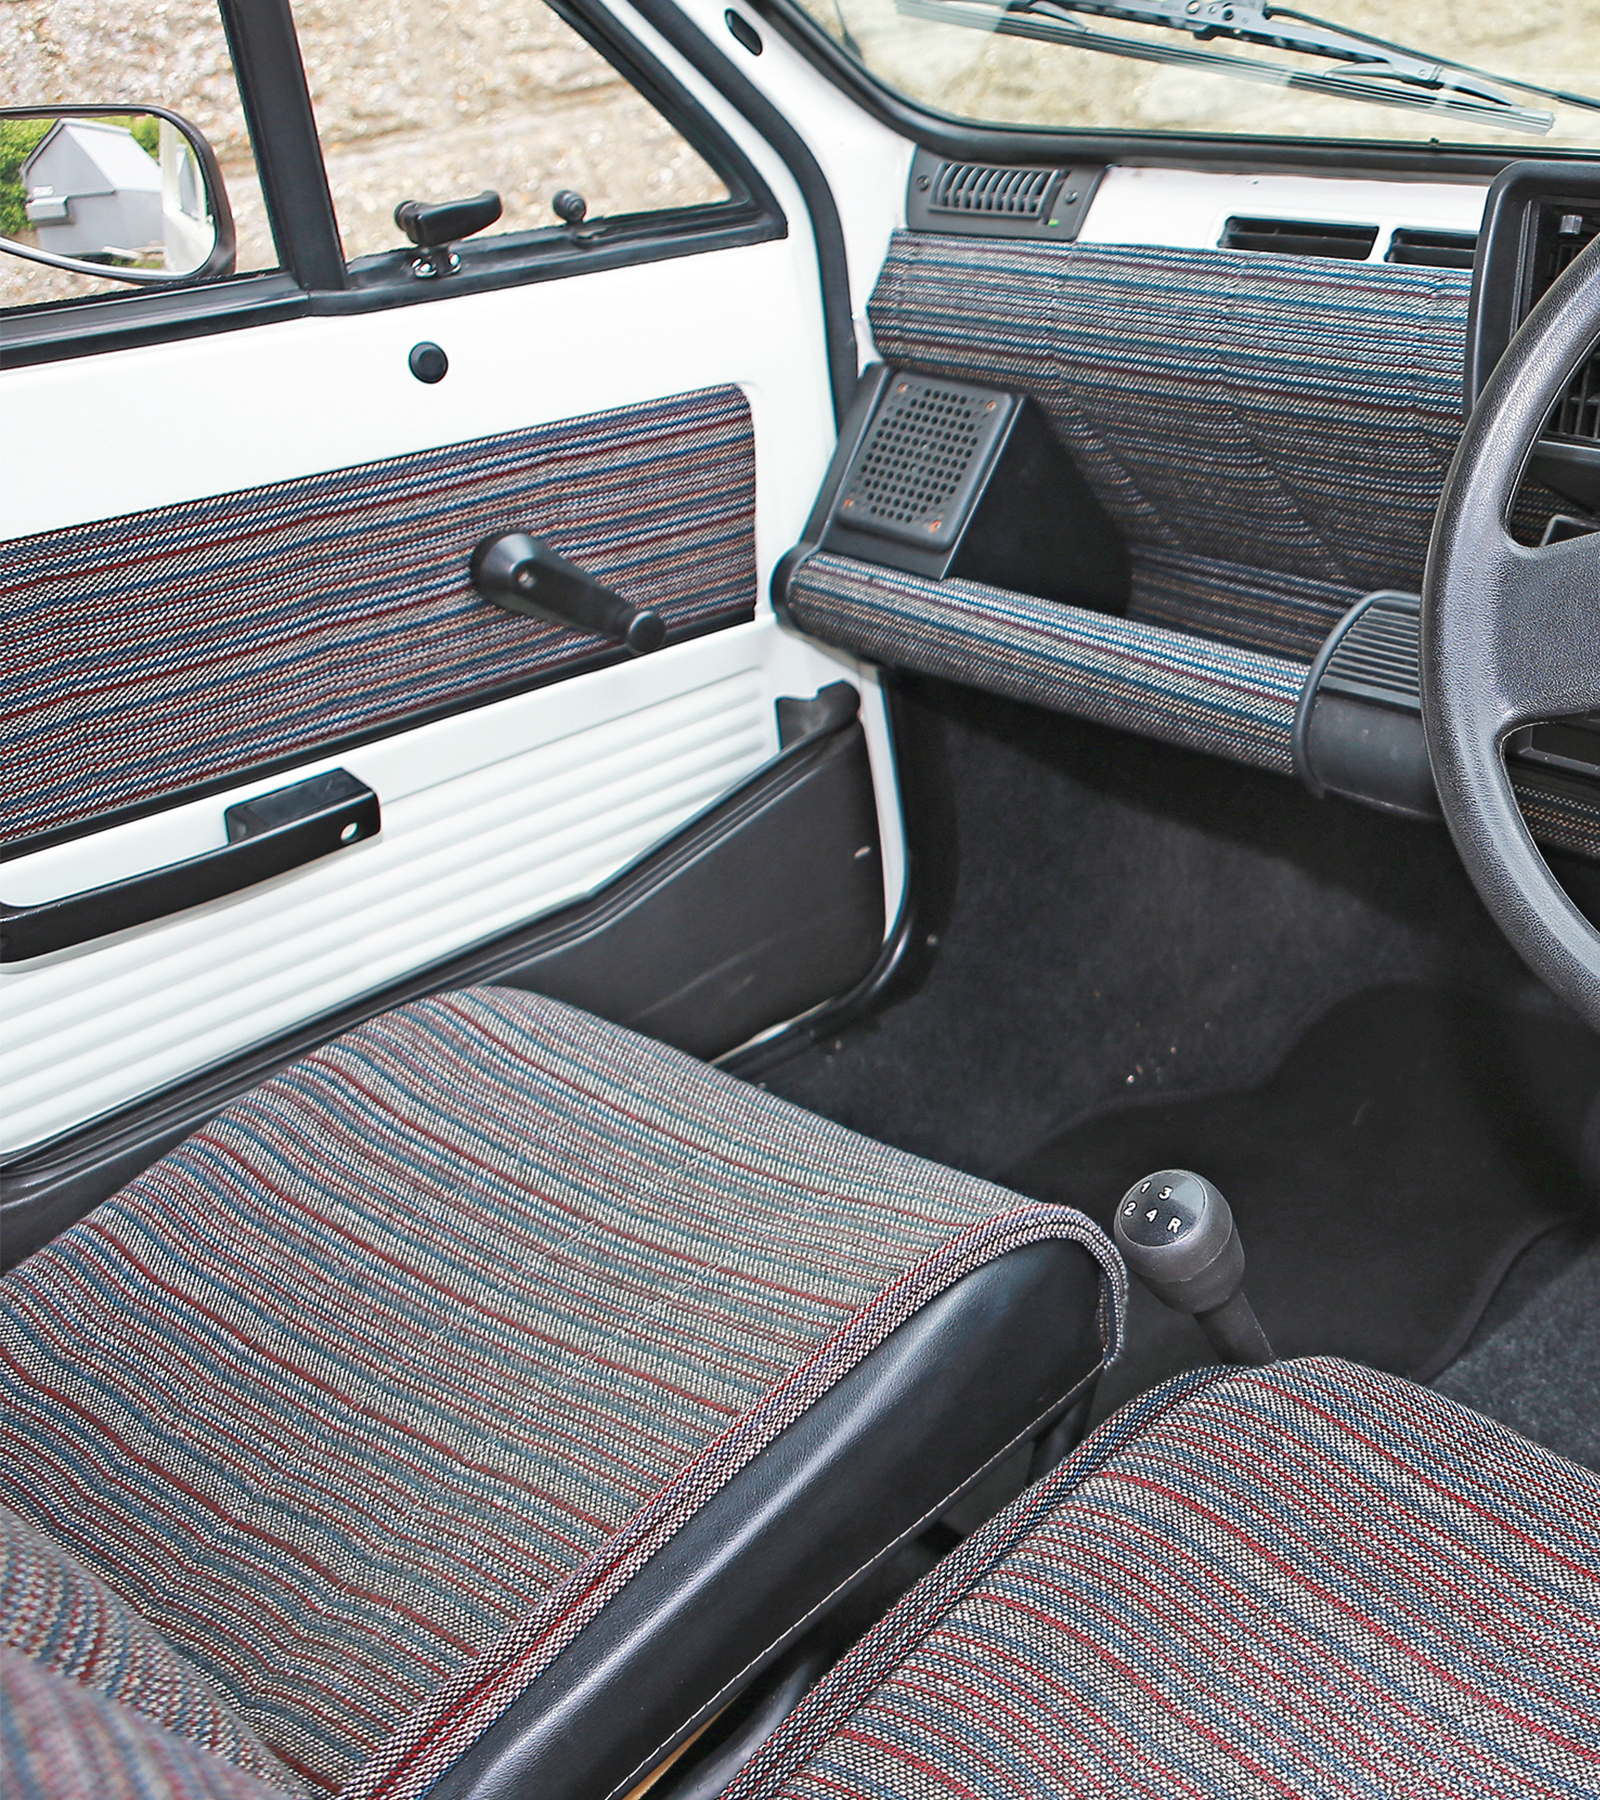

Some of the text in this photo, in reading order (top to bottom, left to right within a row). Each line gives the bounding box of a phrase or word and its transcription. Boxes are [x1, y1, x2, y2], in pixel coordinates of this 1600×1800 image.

[1141, 1182, 1151, 1194] 1
[1158, 1187, 1172, 1200] 3
[1123, 1201, 1137, 1217] 2
[1146, 1209, 1158, 1223] 4
[1167, 1217, 1182, 1234] R
